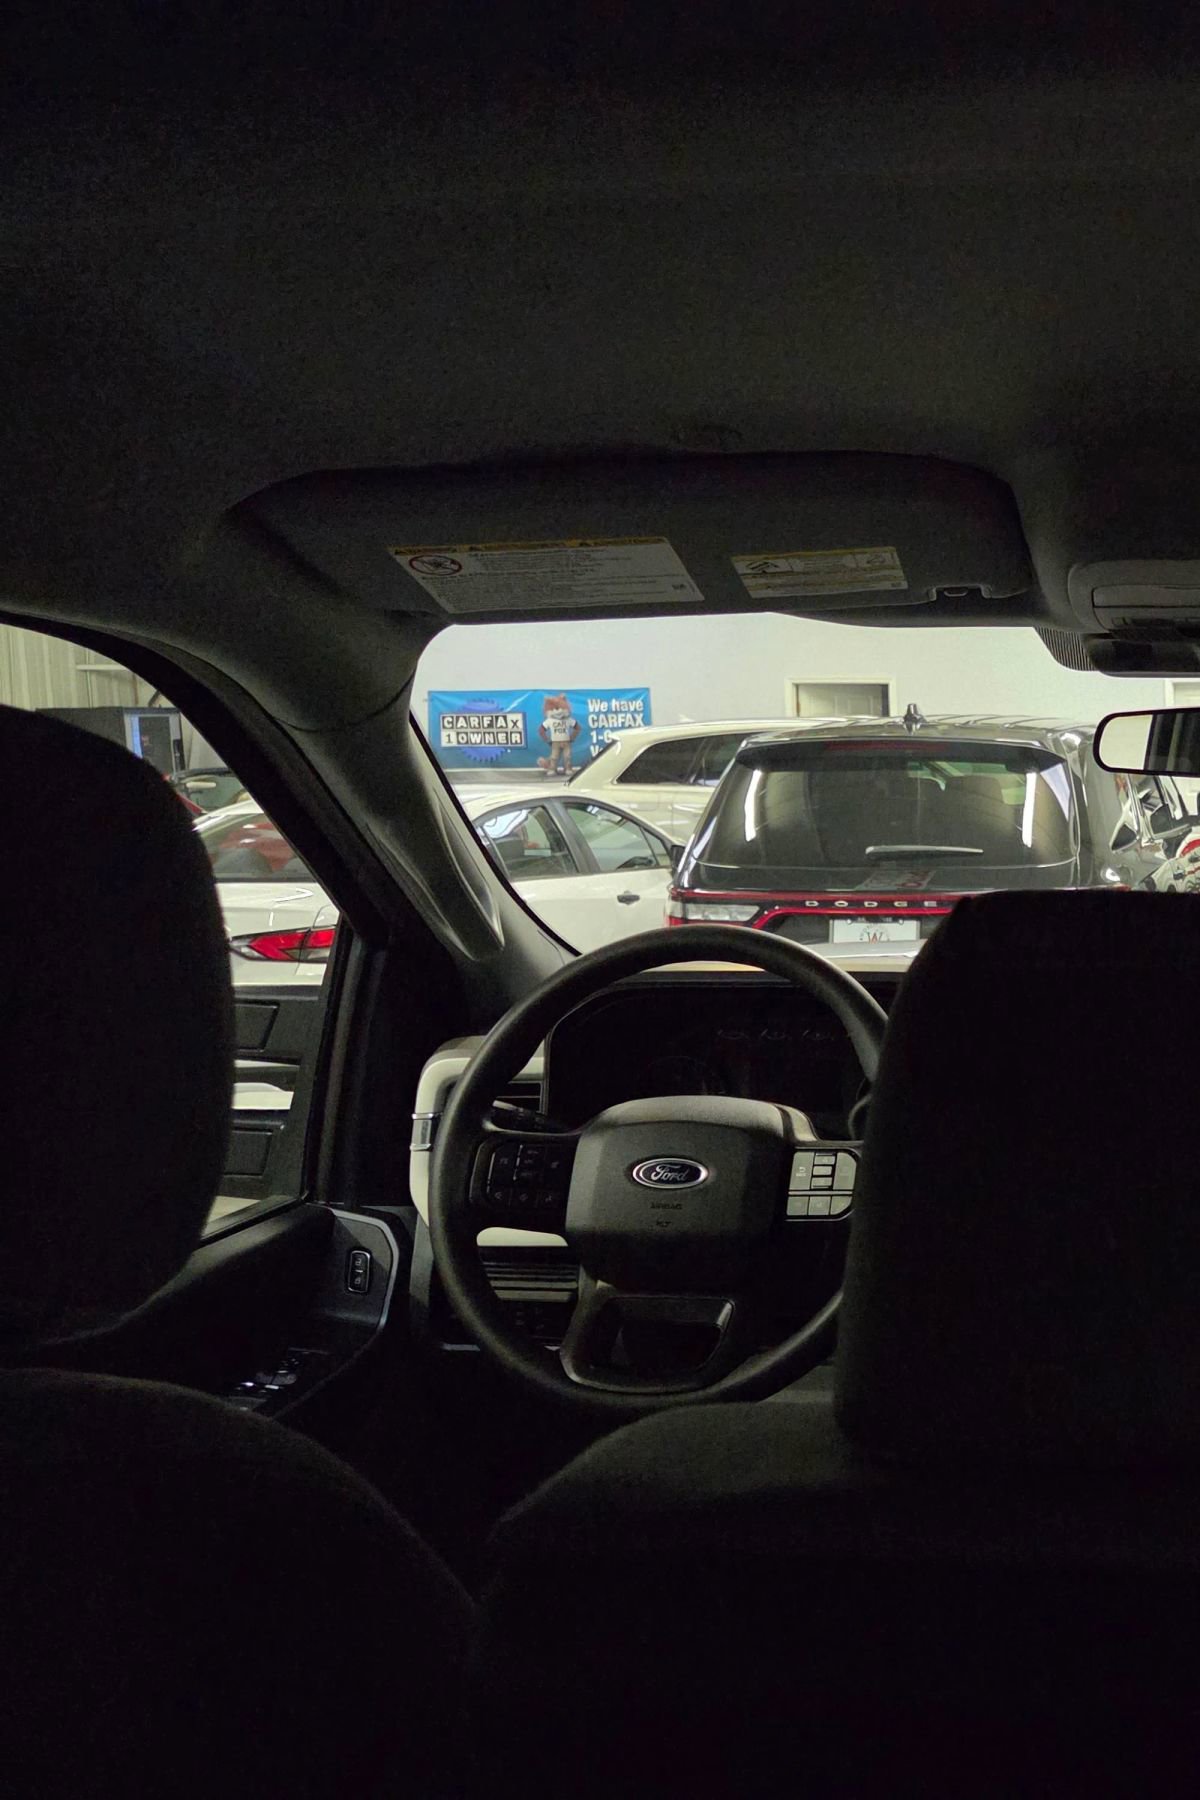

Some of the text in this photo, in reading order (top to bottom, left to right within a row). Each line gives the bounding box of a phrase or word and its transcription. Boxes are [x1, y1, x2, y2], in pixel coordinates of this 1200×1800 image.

[588, 697, 644, 712] We have
[442, 715, 521, 729] CARFAX
[588, 713, 644, 728] CARFAX
[651, 1164, 688, 1181] Ford
